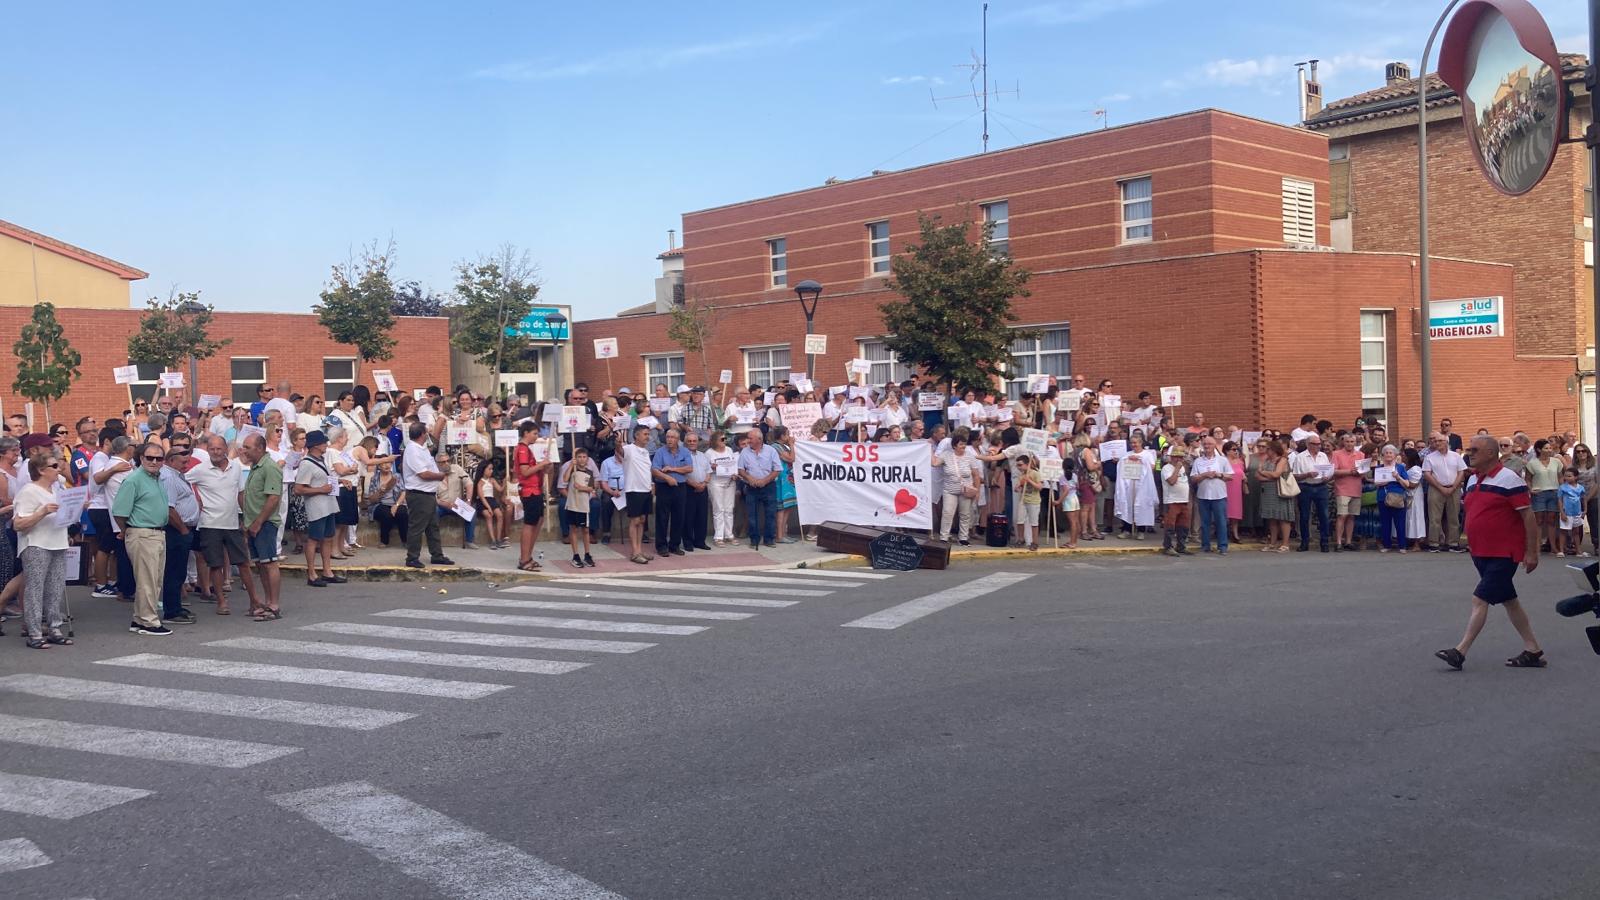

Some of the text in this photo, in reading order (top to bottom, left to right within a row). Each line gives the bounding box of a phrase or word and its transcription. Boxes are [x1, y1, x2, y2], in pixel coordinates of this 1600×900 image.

[1460, 298, 1492, 310] salud
[533, 320, 543, 328] de
[1429, 325, 1492, 337] URGENCIAS
[807, 340, 825, 352] SOS
[842, 444, 879, 462] SOS
[871, 465, 923, 483] RURAL
